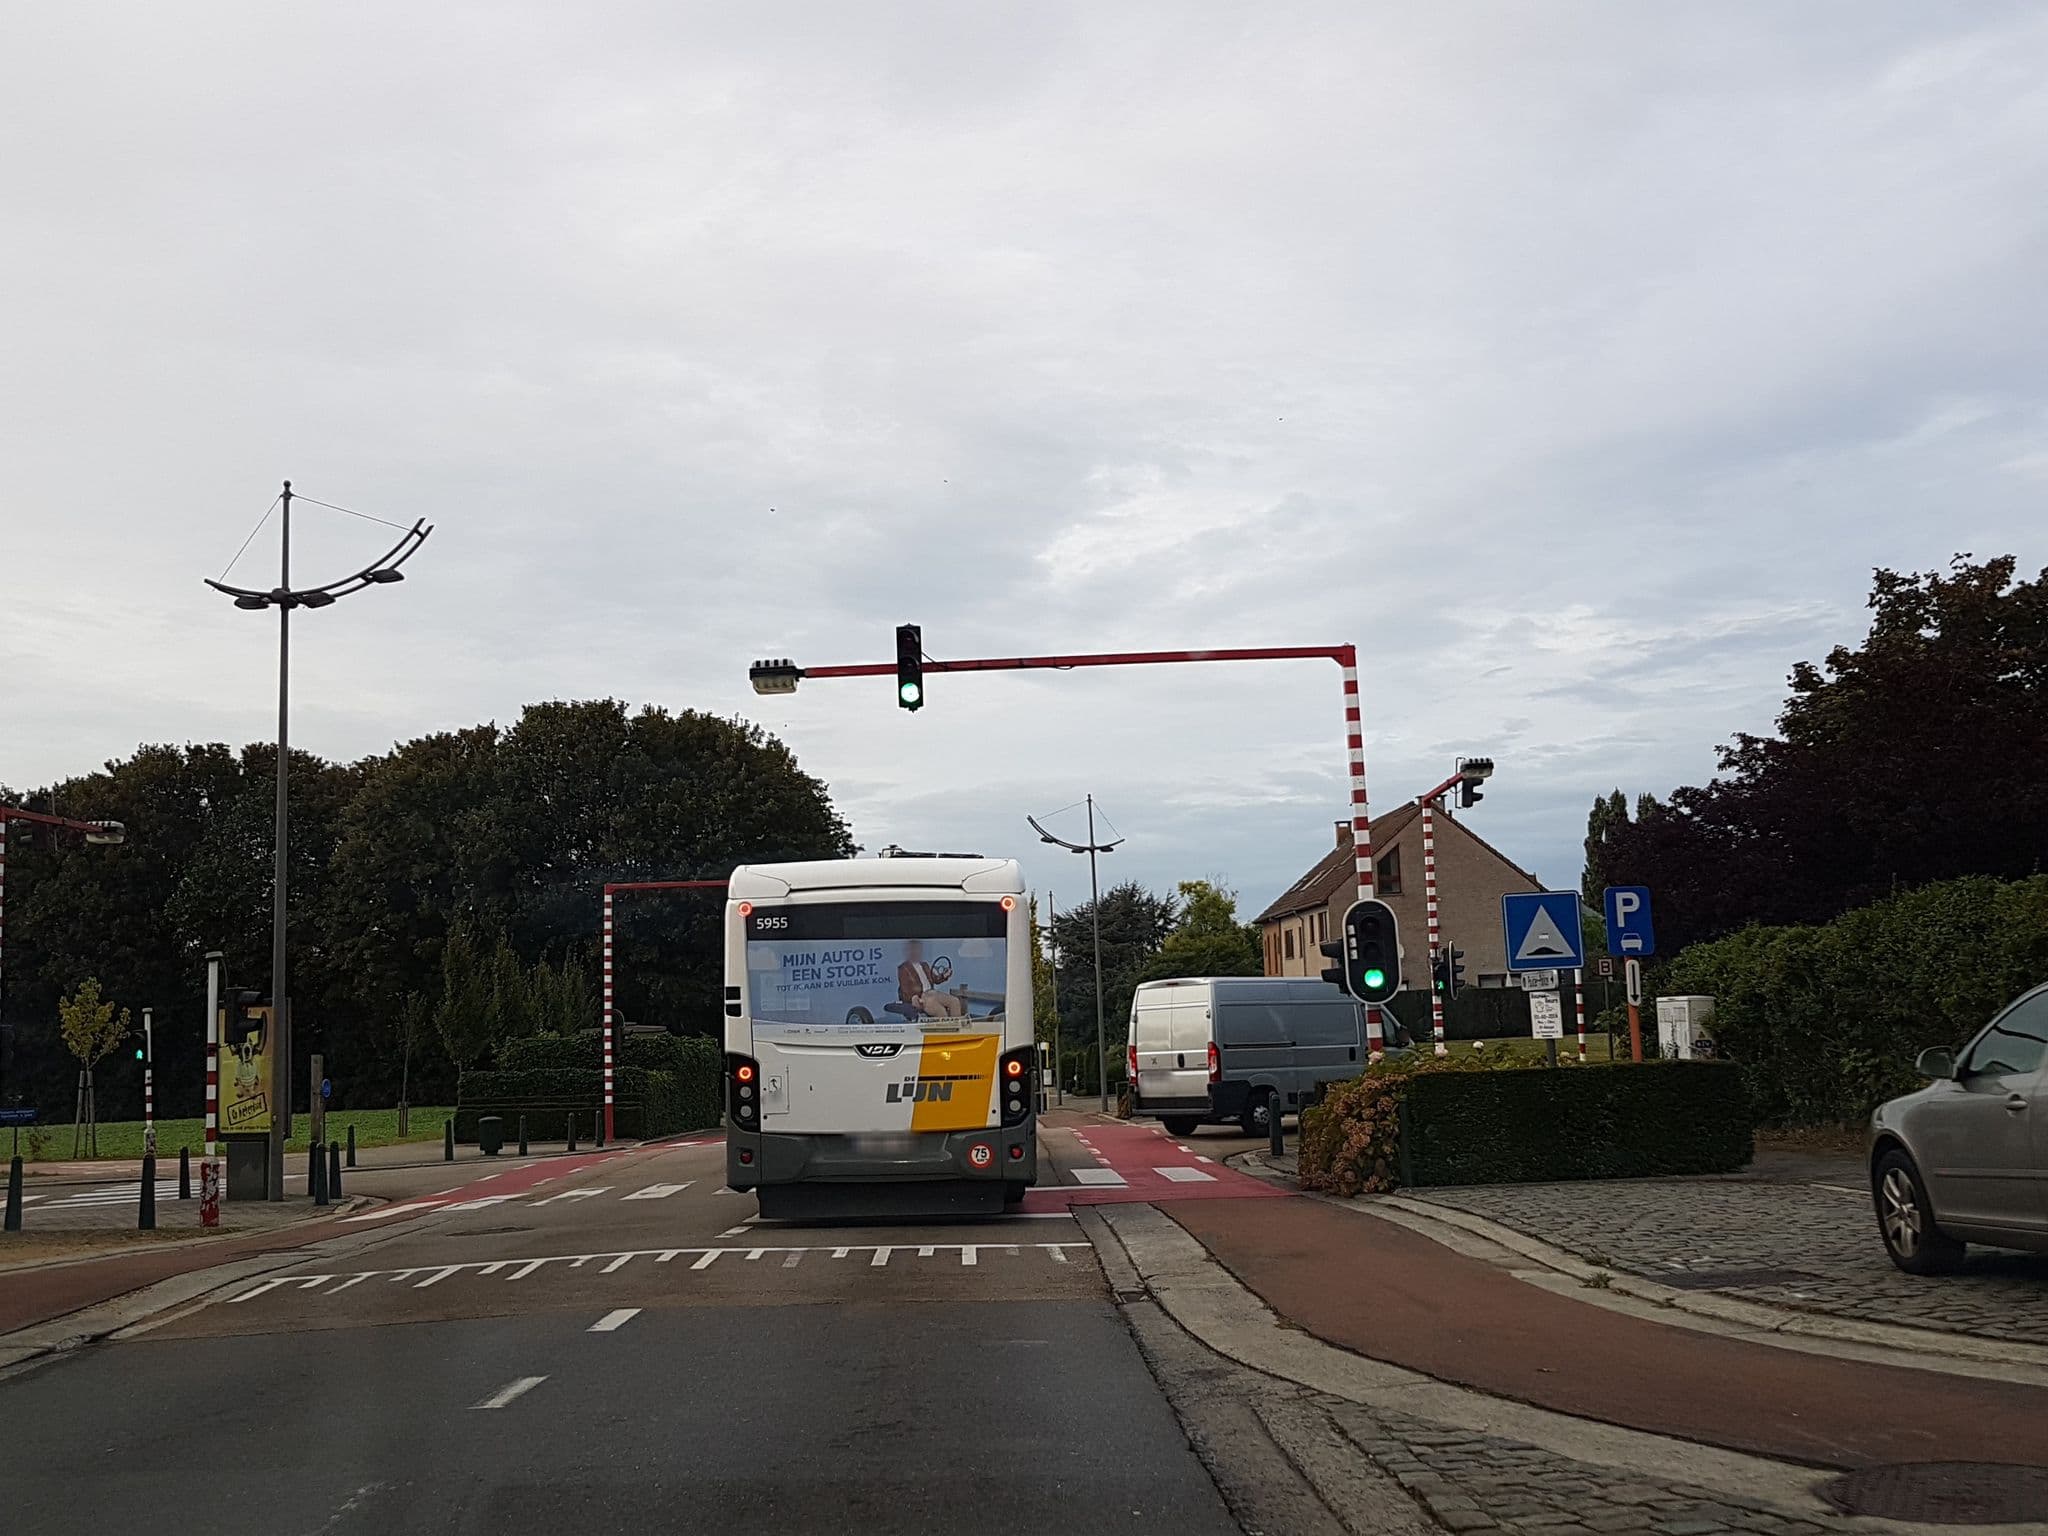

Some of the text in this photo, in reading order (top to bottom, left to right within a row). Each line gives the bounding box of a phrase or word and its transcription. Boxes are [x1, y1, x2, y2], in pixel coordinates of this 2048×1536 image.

[1616, 892, 1640, 927] P
[756, 916, 788, 929] 5955
[782, 947, 883, 967] MIJN AUTO IS
[792, 963, 878, 981] EEN STORT.
[776, 984, 791, 992] TOT
[793, 983, 802, 991] IK
[804, 982, 821, 990] AAN
[837, 977, 870, 987] VUILBAK
[861, 1045, 895, 1055] VDL
[974, 1147, 987, 1158] 75
